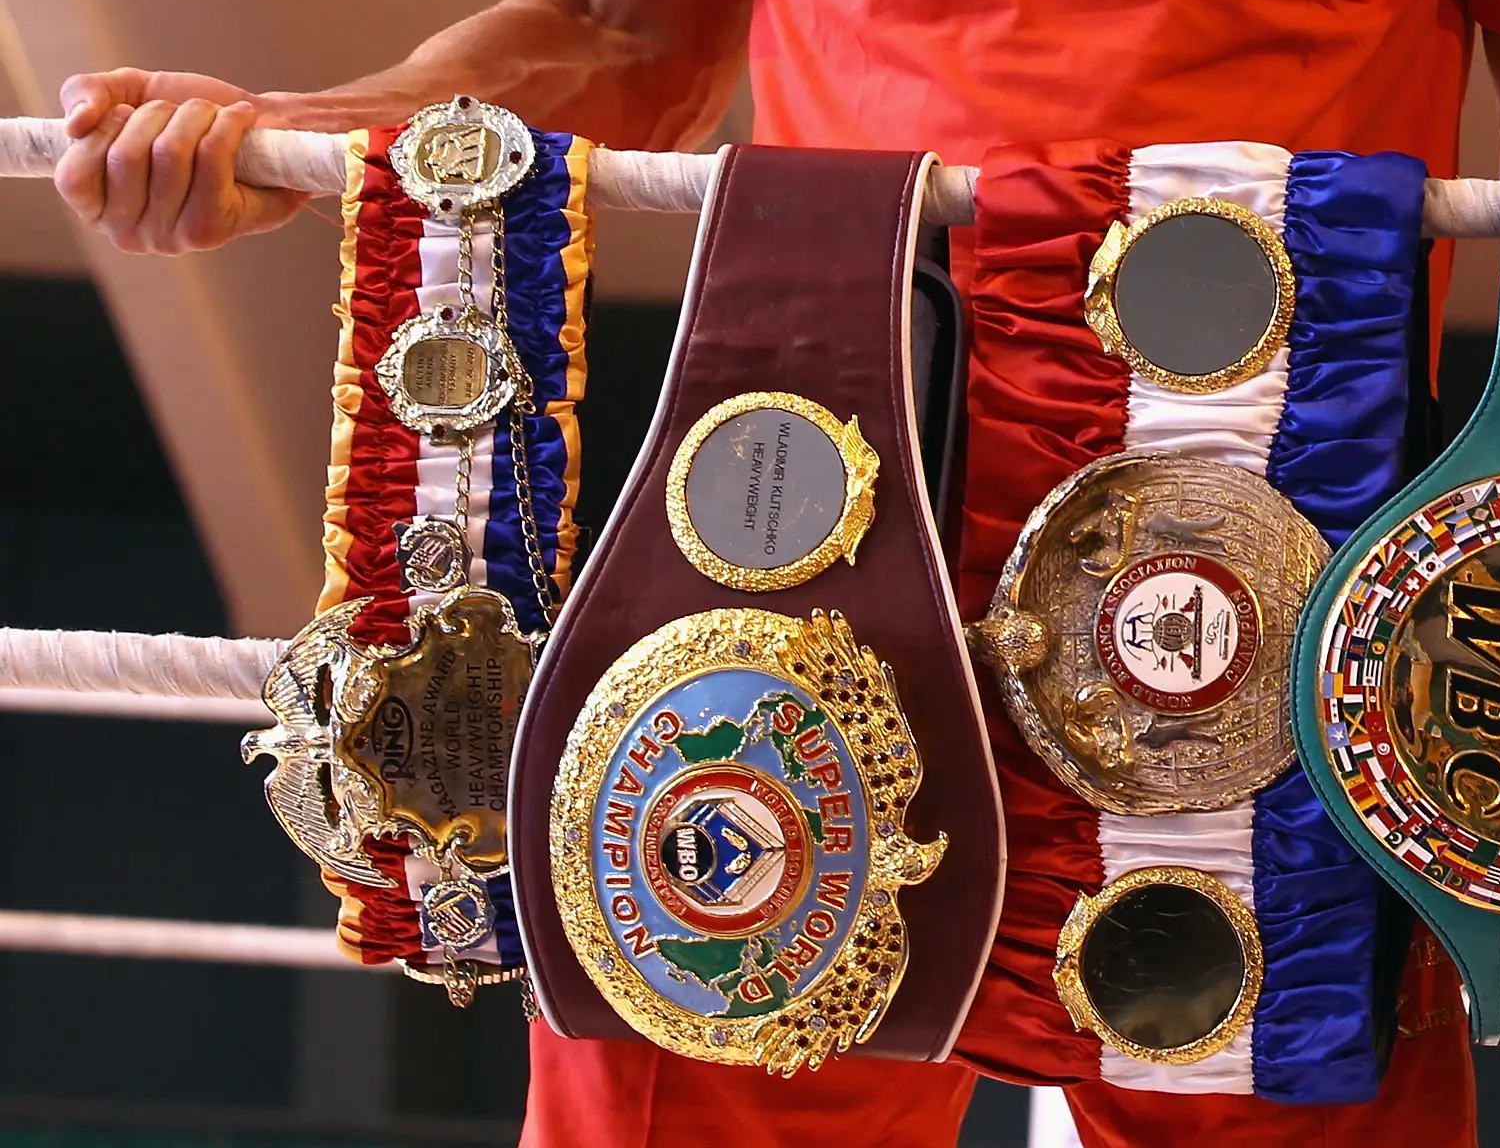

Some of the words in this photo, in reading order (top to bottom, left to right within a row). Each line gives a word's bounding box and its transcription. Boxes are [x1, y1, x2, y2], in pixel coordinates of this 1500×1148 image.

[744, 442, 765, 531] HEAVYWEIGHT
[772, 422, 791, 481] WLADIMIR
[764, 485, 785, 555] KLITSCHKO
[423, 650, 455, 714] AWARD
[380, 706, 414, 784] RING
[421, 723, 460, 821] MAGAZINE
[466, 663, 484, 806] HEAVYWEIGHT
[486, 658, 504, 811] CHAMPIONSHIP
[772, 701, 854, 854] SUPER
[602, 710, 680, 959] CHAMPION
[750, 780, 799, 837] WORLD
[676, 827, 699, 882] WBO
[737, 871, 853, 1004] WORLD
